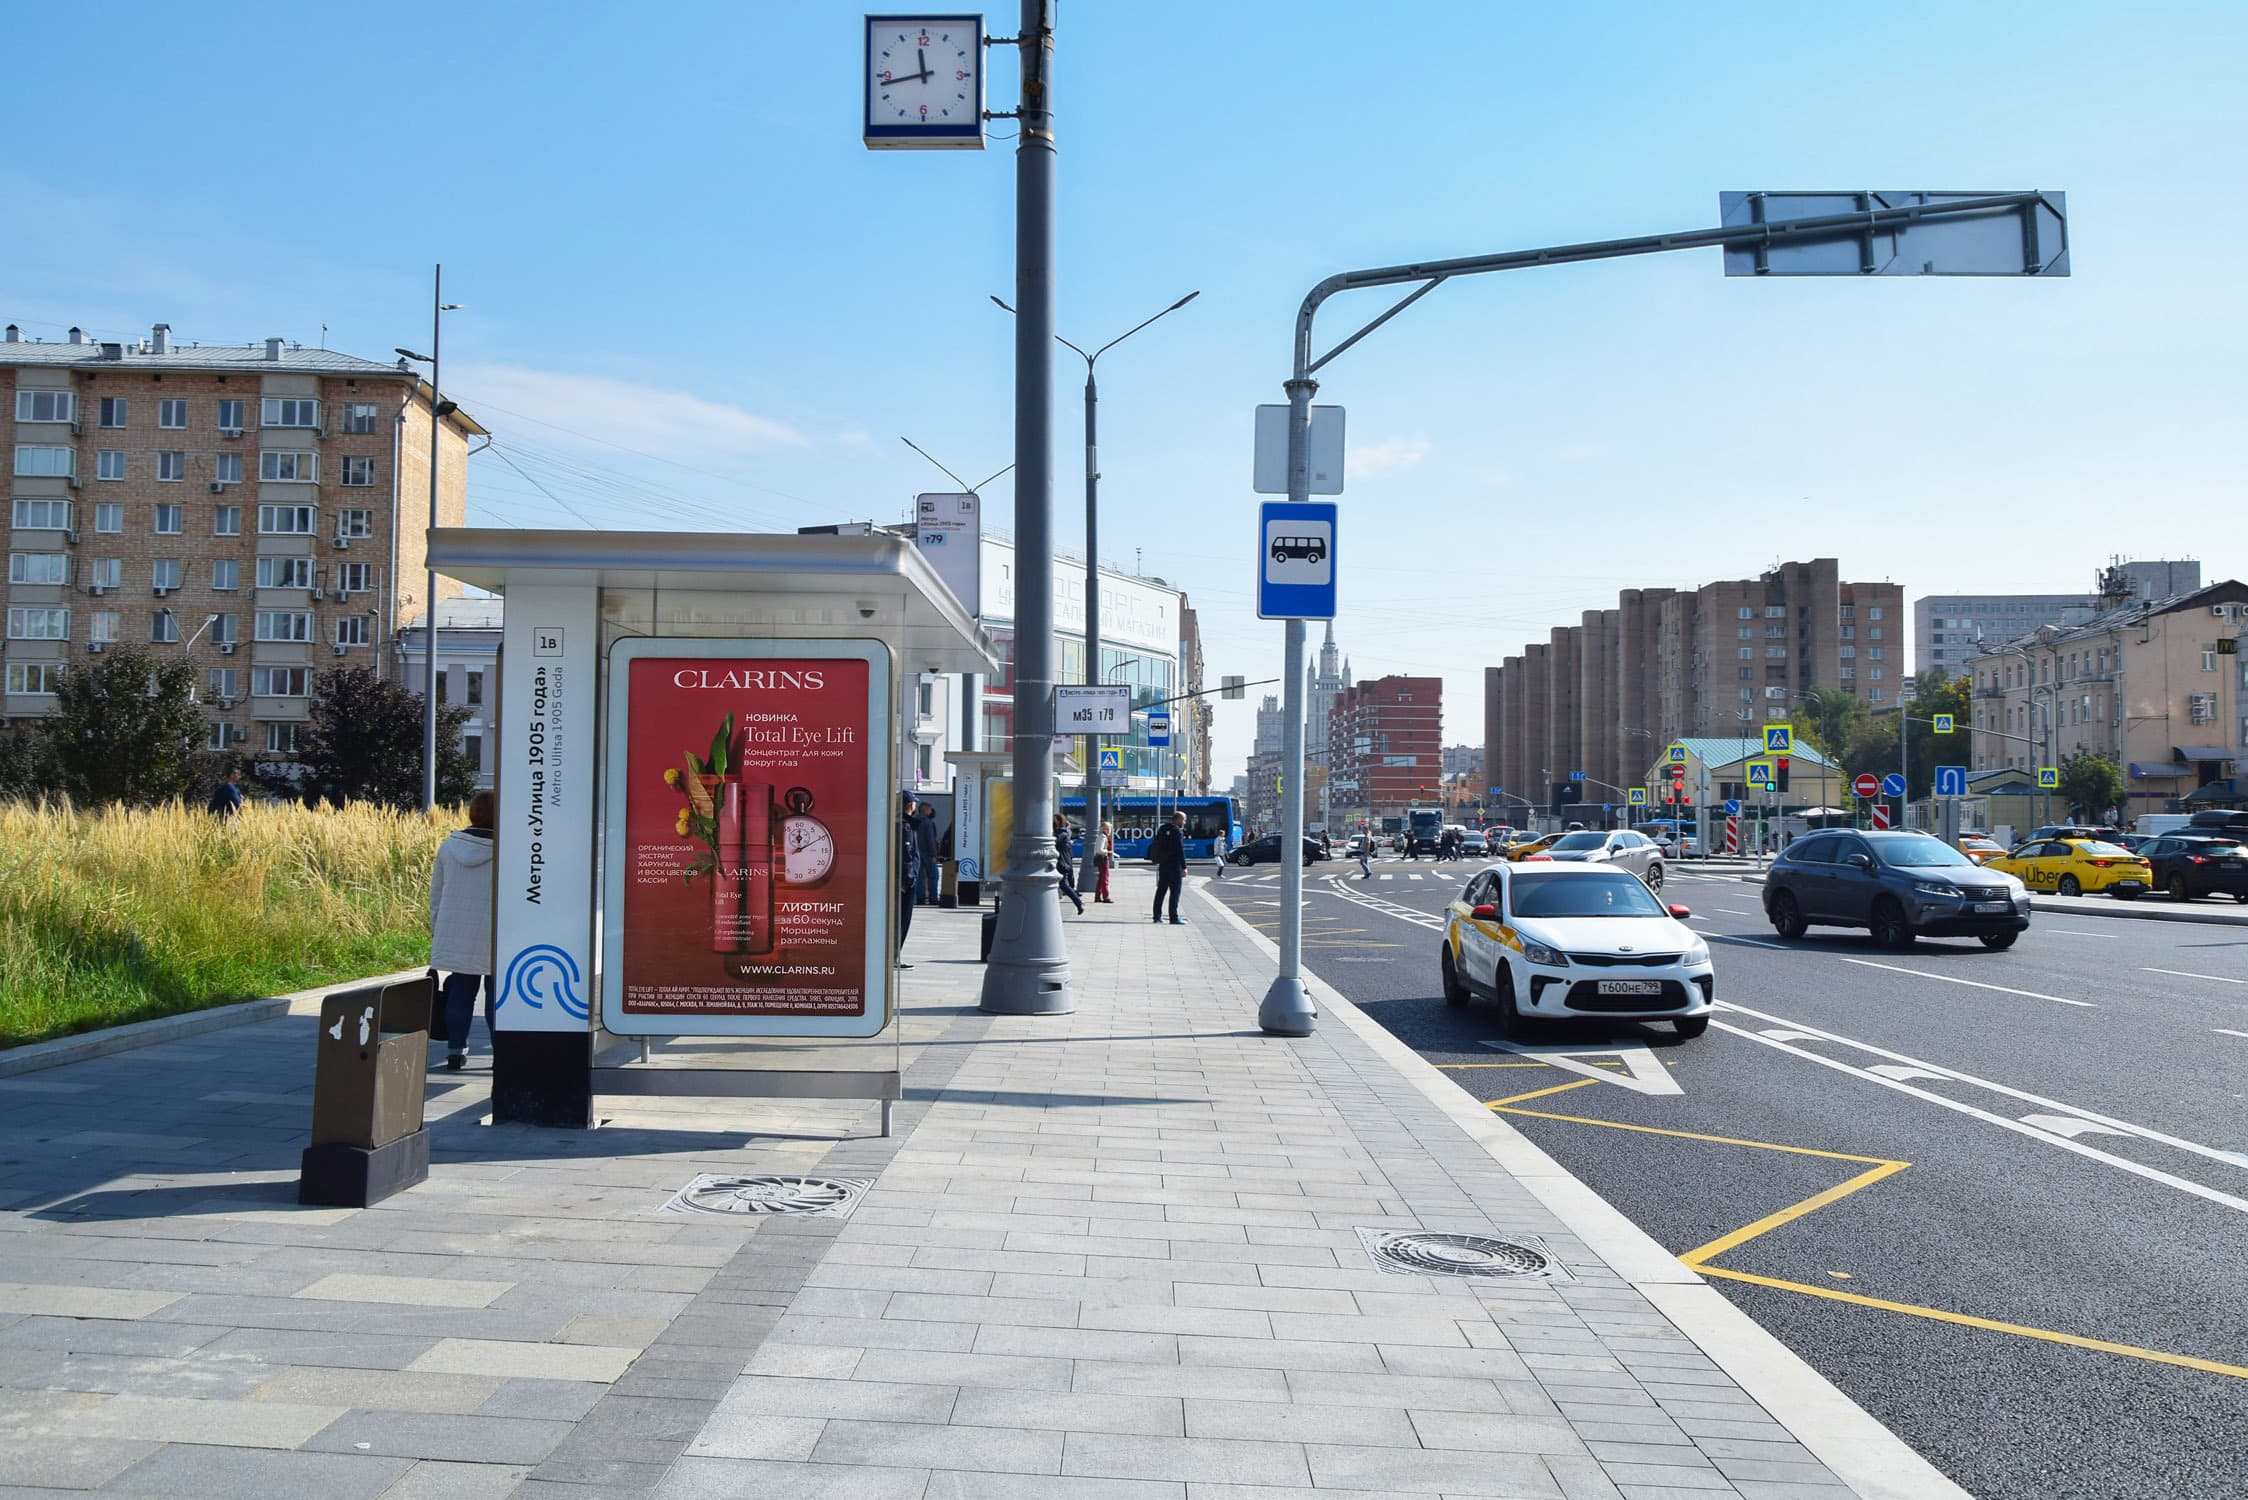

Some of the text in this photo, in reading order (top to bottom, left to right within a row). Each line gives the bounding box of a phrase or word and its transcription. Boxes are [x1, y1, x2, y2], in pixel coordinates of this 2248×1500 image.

[917, 36, 930, 47] 12
[883, 70, 892, 81] 9
[955, 70, 965, 81] 3
[919, 105, 928, 115] 6
[925, 534, 943, 544] т79
[673, 669, 825, 690] CLARINS
[745, 713, 799, 722] НОВИНКА
[1073, 707, 1114, 721] м35 т79
[551, 666, 563, 807] Metro Ulitsa 1905 Goda
[744, 726, 856, 747] Total Eye Lift
[744, 748, 800, 757] Концентрат
[744, 760, 776, 768] вокруг
[526, 666, 548, 904] Метро «Улица 1905 года»
[638, 844, 694, 852] ОРГАНИЧЕСКИЙ
[721, 868, 768, 876] LARINS
[2025, 866, 2060, 884] Uber
[781, 902, 845, 913] ЛИФТИНГ
[781, 917, 791, 925] за
[792, 914, 810, 925] 60
[780, 926, 829, 935] Морщины
[780, 937, 838, 945] разглажены
[740, 965, 835, 975] WWW.CLARINS.RU
[1602, 982, 1641, 993] Т600НЕ
